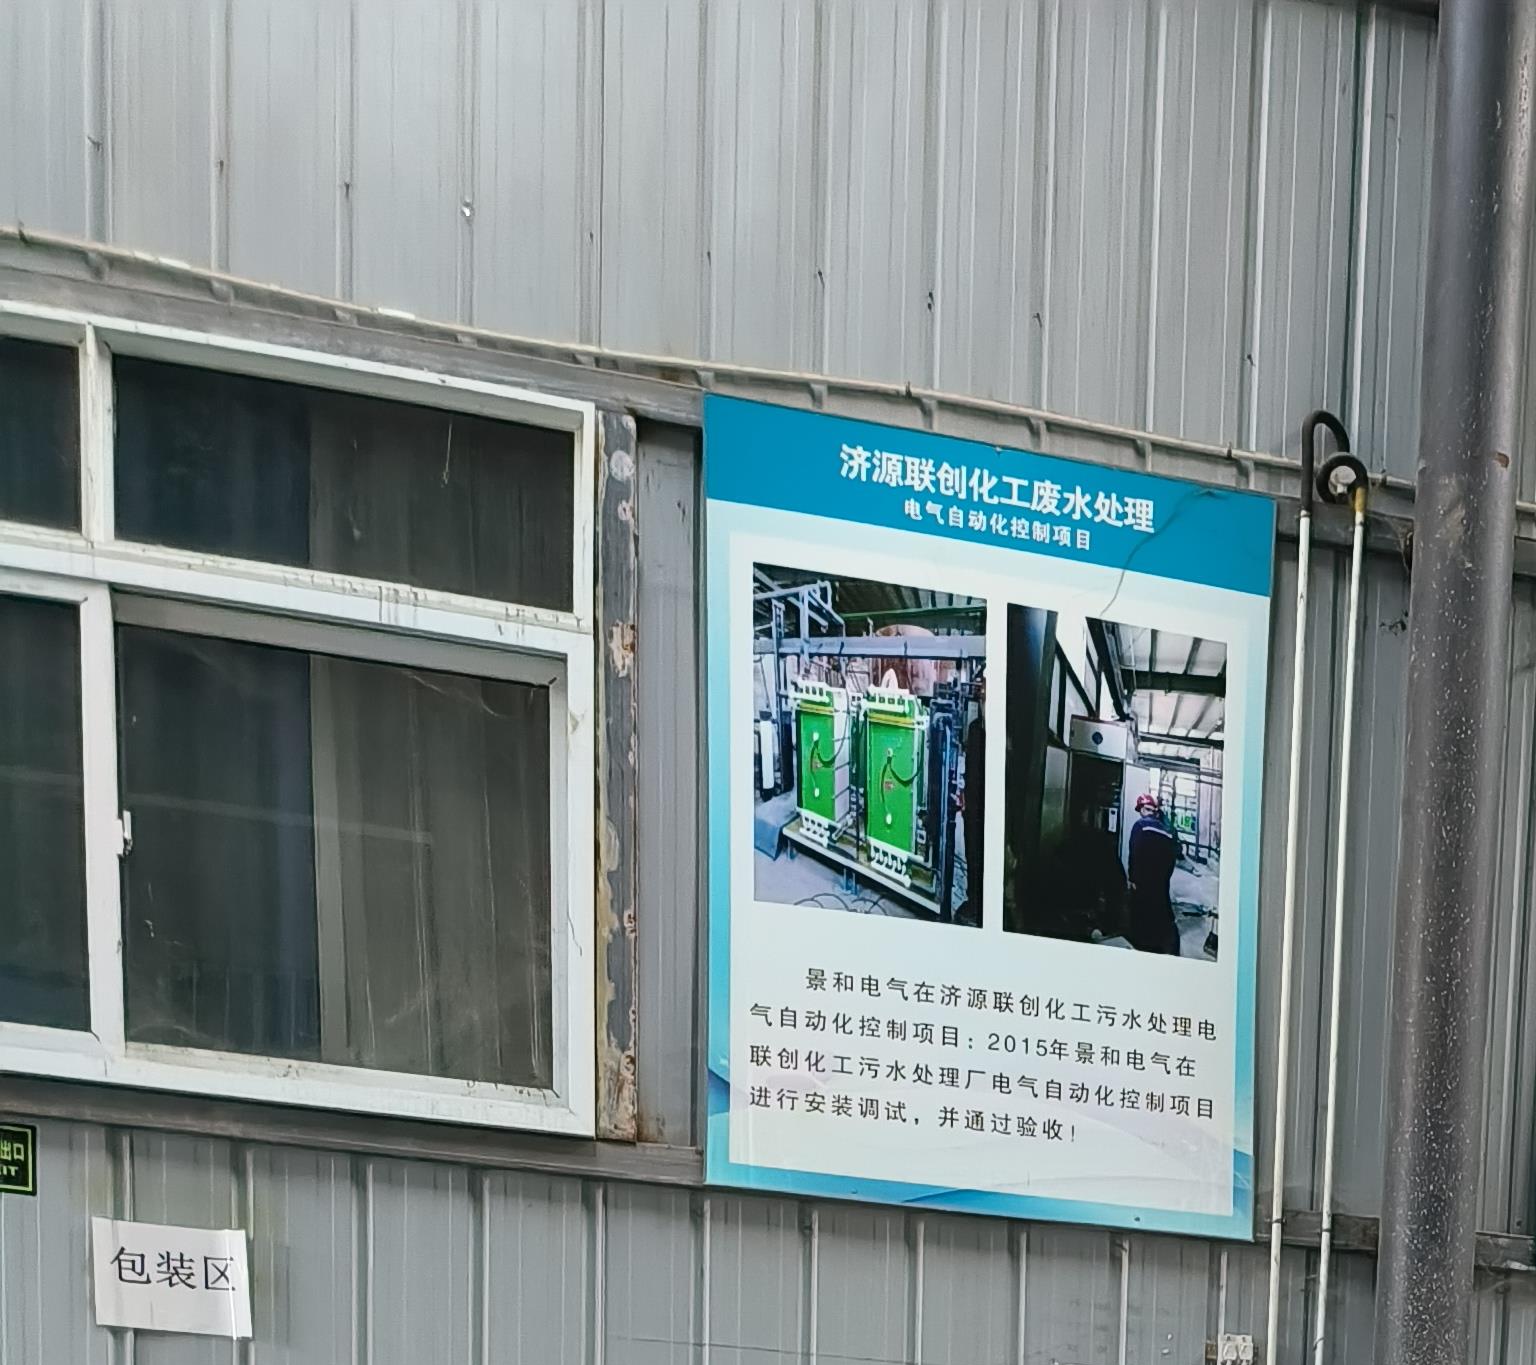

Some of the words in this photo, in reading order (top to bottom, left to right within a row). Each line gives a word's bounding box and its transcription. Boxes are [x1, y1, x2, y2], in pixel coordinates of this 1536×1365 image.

[839, 443, 1155, 534] 济源联创化工废水处理
[904, 498, 1091, 551] 电气自动化控制项目
[804, 968, 1217, 1041] 景和电气在济源联创化工污水处理电
[749, 1044, 1214, 1119] 联创化工污水处理厂电气自动化控制项目
[110, 1246, 236, 1291] 包装区
